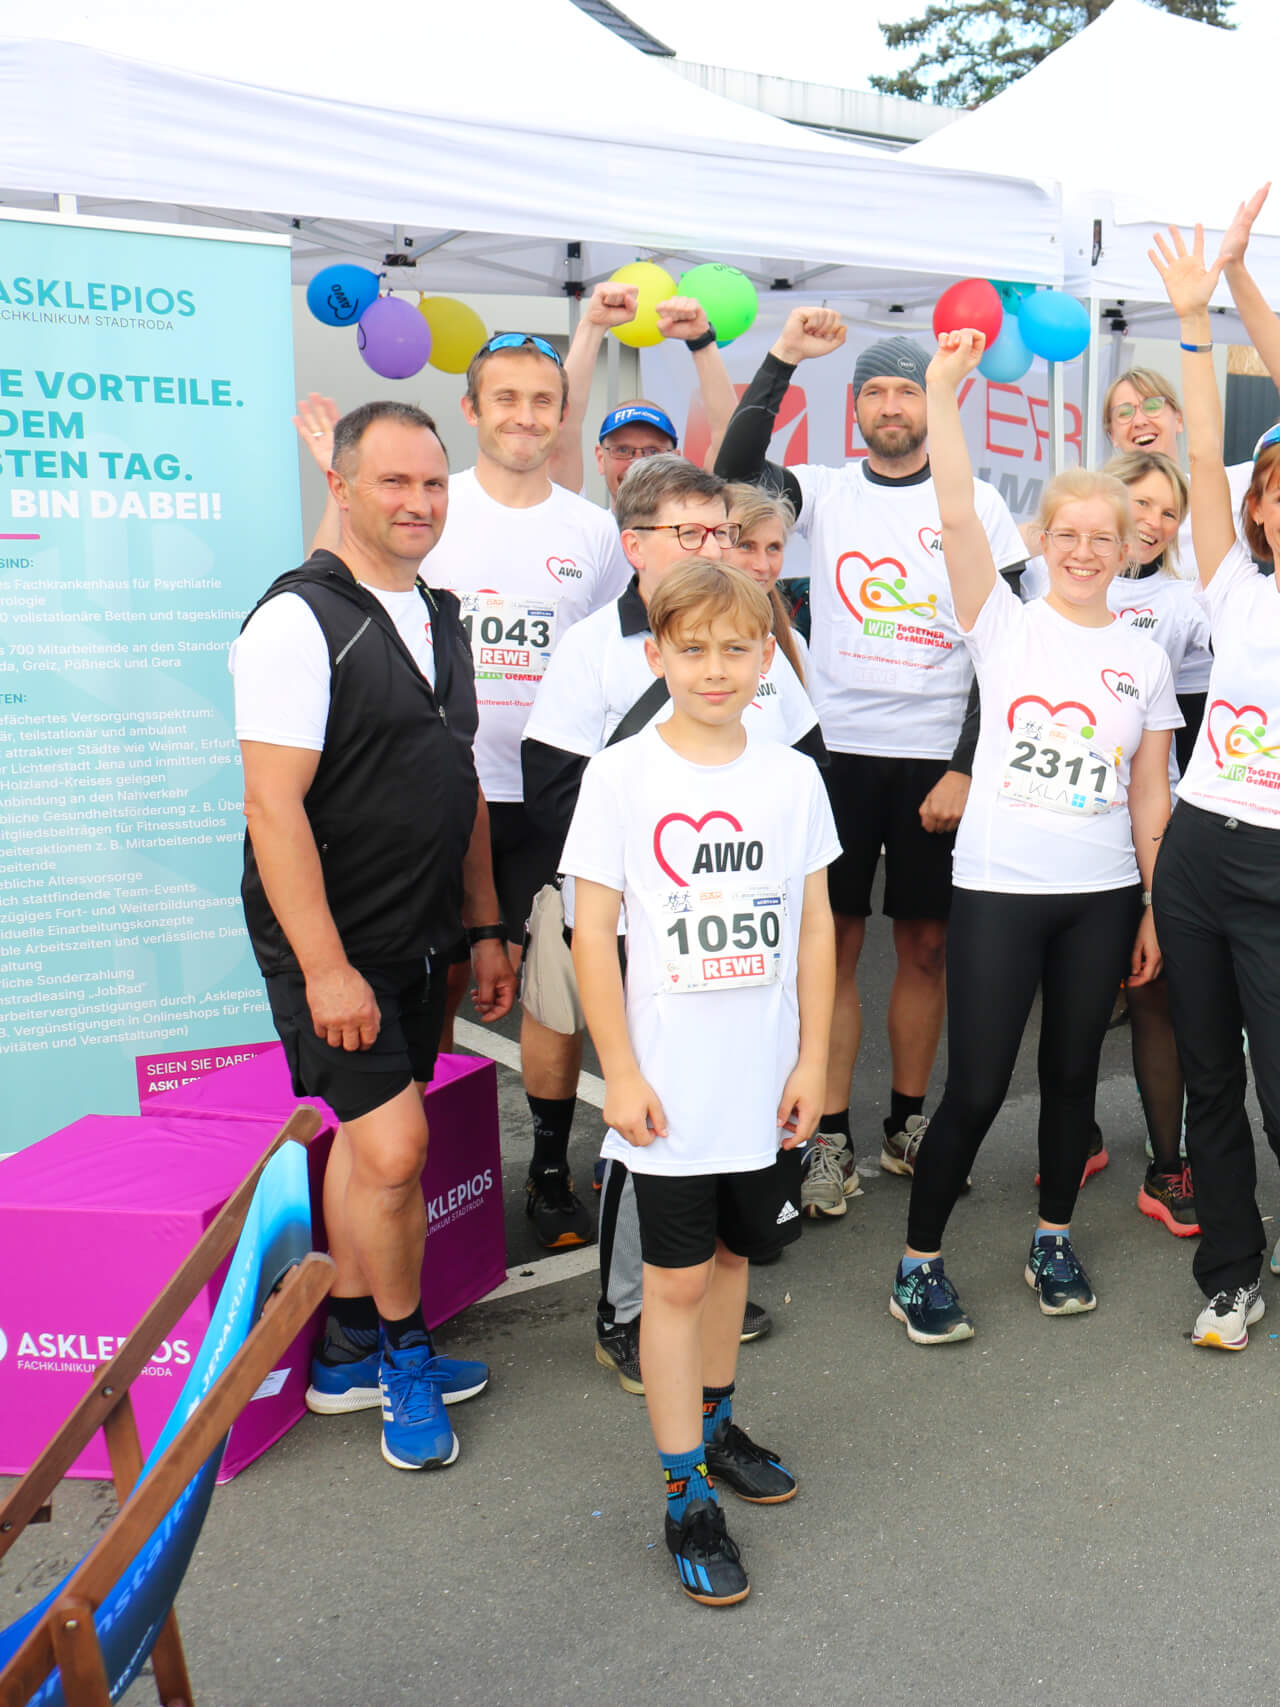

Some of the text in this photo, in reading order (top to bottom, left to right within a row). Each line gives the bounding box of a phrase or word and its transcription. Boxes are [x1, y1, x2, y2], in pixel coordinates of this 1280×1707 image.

[0, 309, 174, 331] CHKLINIKUM STADTRODA
[35, 370, 244, 408] VORTEILE.
[0, 449, 193, 481] TEN TAG.
[10, 489, 222, 520] BIN DABEI!
[558, 566, 583, 580] AWO
[15, 578, 129, 591] Fachkrankenhaus
[133, 577, 151, 590] für
[154, 577, 222, 592] Psychiatrie
[12, 611, 101, 624] vollstationäre
[104, 610, 147, 622] Betten
[150, 609, 173, 621] und
[462, 614, 551, 649] 1043
[868, 620, 895, 638] WIR
[8, 644, 34, 656] 700
[38, 642, 128, 656] Mitarbeitende
[132, 643, 147, 653] an
[151, 641, 175, 653] den
[482, 649, 530, 666] REWE
[124, 658, 148, 670] und
[151, 657, 182, 668] Gera
[71, 709, 215, 725] Versorgungsspektrum:
[20, 728, 98, 742] teilstationär
[101, 726, 125, 738] und
[128, 724, 187, 737] ambulant
[5, 746, 73, 759] attraktiver
[77, 743, 120, 756] Städte
[124, 741, 145, 753] wie
[11, 760, 90, 775] Lichterstadt
[95, 759, 126, 771] Jena
[129, 757, 152, 769] und
[156, 755, 206, 768] inmitten
[209, 753, 231, 765] des
[1009, 741, 1107, 793] 2311
[116, 774, 166, 788] gelegen
[70, 794, 86, 804] an
[89, 791, 114, 803] den
[117, 788, 188, 803] Nahverkehr
[42, 806, 186, 822] Gesundheitsförderung
[115, 822, 134, 834] für
[136, 816, 226, 832] Fitnessstudios
[126, 834, 213, 849] Mitarbeitende
[692, 840, 763, 875] AWO
[48, 871, 144, 887] Altersvorsorge
[23, 888, 111, 905] stattfindende
[114, 882, 198, 898] Team-Events
[55, 908, 87, 920] Fort-
[91, 905, 116, 917] und
[48, 915, 194, 937] Einarbeitungskonzepte
[667, 911, 780, 955] 1050
[25, 938, 112, 954] Arbeitszeiten
[115, 935, 139, 947] und
[142, 930, 216, 945] verlässliche
[704, 955, 764, 980] REWE
[37, 968, 135, 986] Sonderzahlung
[160, 994, 196, 1007] durch
[14, 1017, 124, 1037] Vergünstigungen
[128, 1015, 140, 1026] in
[143, 1007, 220, 1024] Onlineshops
[222, 1005, 240, 1016] für
[52, 1036, 77, 1048] und
[79, 1024, 189, 1045] Veranstaltungen)
[146, 1060, 187, 1076] SEIEN
[191, 1057, 212, 1071] SIE
[427, 1168, 493, 1224] KLEPIOS
[17, 1332, 191, 1365] ASKLEOS
